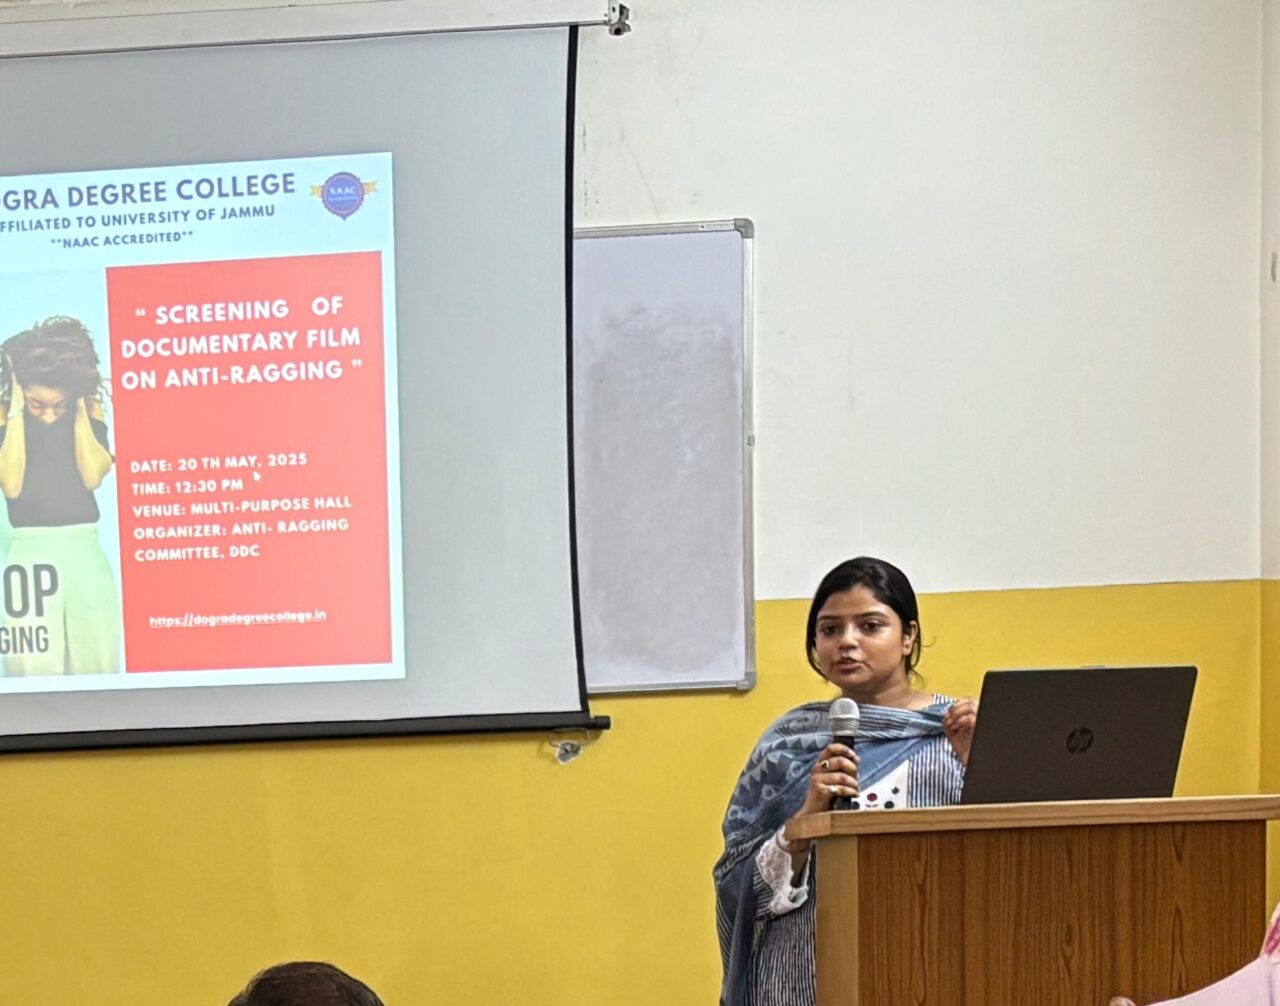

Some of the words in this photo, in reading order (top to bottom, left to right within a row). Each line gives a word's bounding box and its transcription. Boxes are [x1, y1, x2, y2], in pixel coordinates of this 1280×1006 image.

[67, 181, 167, 207] DEGREE
[176, 173, 295, 200] COLLEGE
[76, 216, 96, 228] TO
[101, 210, 190, 227] UNIVERSITY
[196, 208, 216, 221] OF
[220, 204, 275, 220] JAMMU
[155, 299, 289, 325] SCREENING
[311, 296, 343, 316] OF
[121, 330, 298, 358] DOCUMENTARY
[307, 327, 360, 349] FILM
[121, 369, 156, 390] ON
[165, 360, 343, 388] ANTI-RAGGING
[130, 459, 172, 474] DATE:
[177, 458, 197, 471] 20
[202, 457, 220, 470] TH
[268, 453, 308, 467] 2025
[131, 482, 170, 495] TIME:
[175, 480, 217, 494] 12:30
[222, 478, 243, 491] PM
[132, 503, 186, 518] VENUE:
[191, 497, 310, 515] MULTI-PURPOSE
[314, 496, 352, 509] HALL
[133, 525, 226, 540] ORGANIZER:
[231, 522, 273, 535] ANTI-
[278, 518, 349, 533] RAGGING
[229, 544, 260, 558] DDC
[149, 609, 327, 628] https://dogradegreecollege.in
